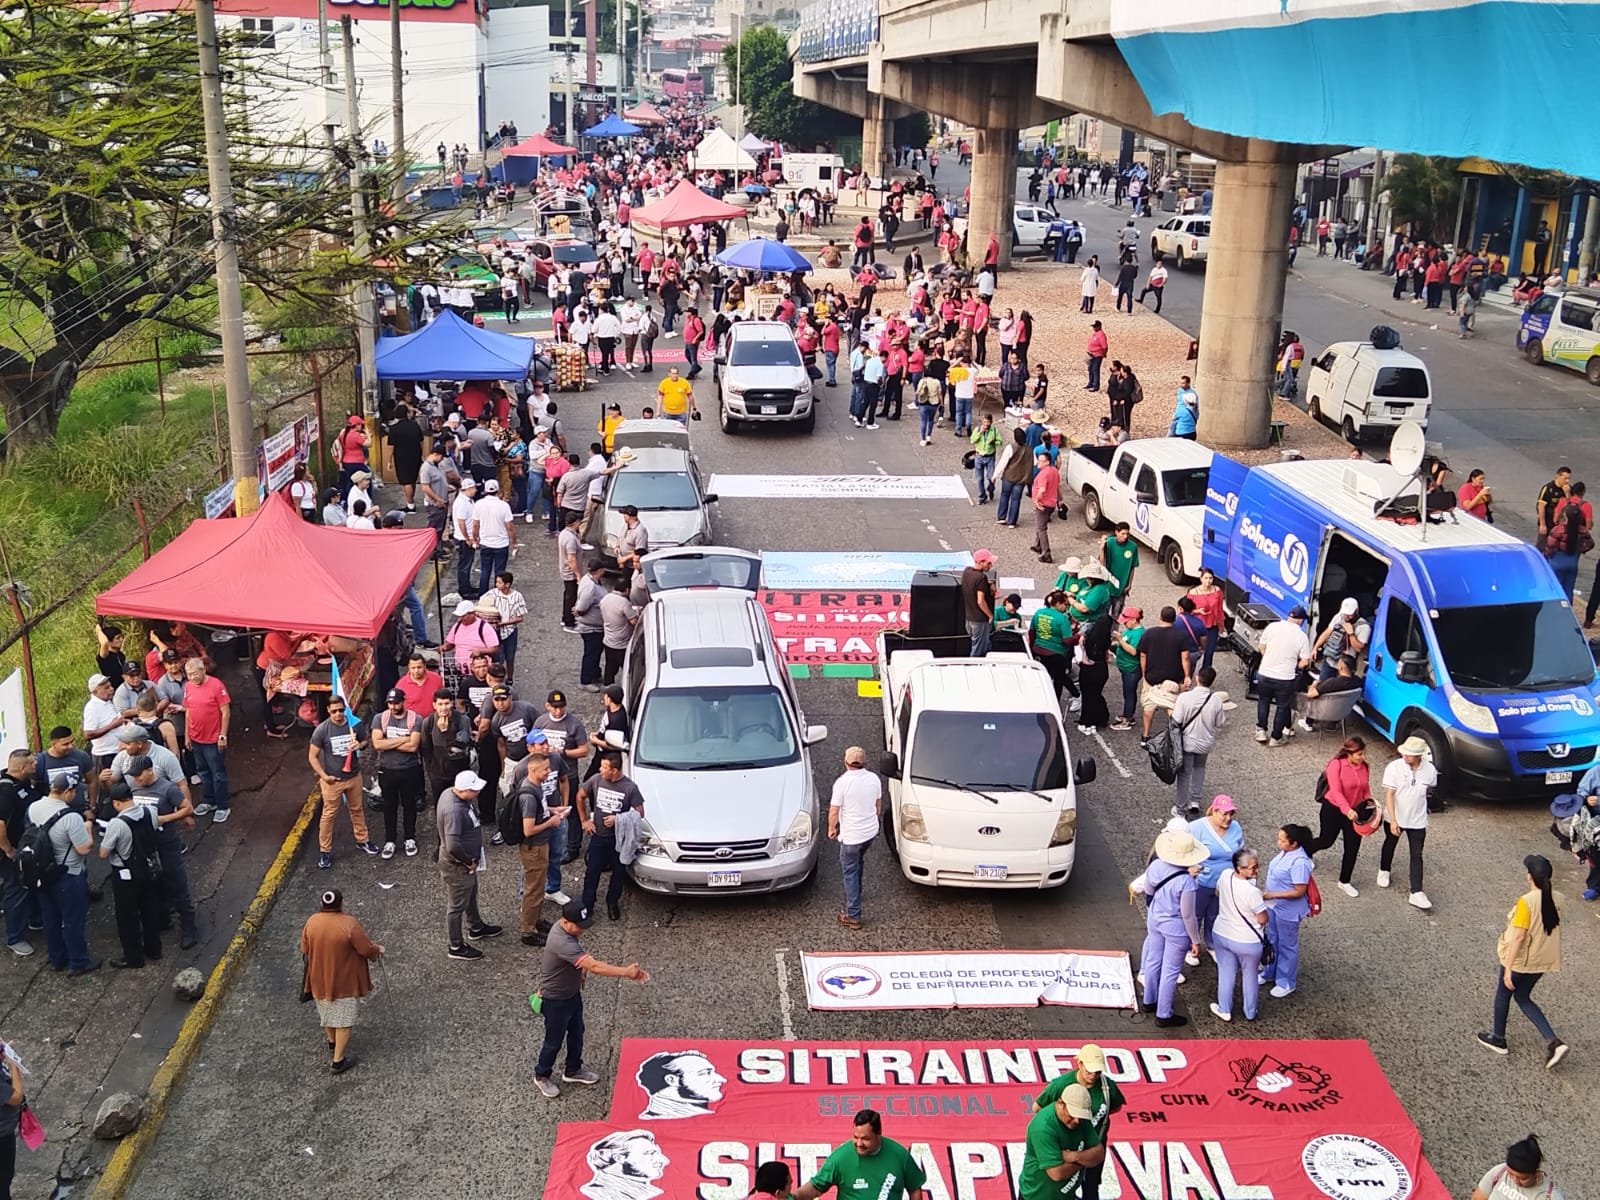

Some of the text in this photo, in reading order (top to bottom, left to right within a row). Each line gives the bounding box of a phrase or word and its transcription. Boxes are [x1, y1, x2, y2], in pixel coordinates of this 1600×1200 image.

[890, 970, 953, 979] COLEGIO
[958, 970, 977, 978] DE
[893, 982, 913, 990] DE
[1018, 980, 1038, 988] DE
[817, 1093, 1007, 1116] SECCIONAL
[1160, 1094, 1210, 1106] CUTH
[1226, 1087, 1345, 1114] SITRAINFOP
[1126, 1110, 1168, 1123] FSM
[1336, 1178, 1386, 1187] FUTH
